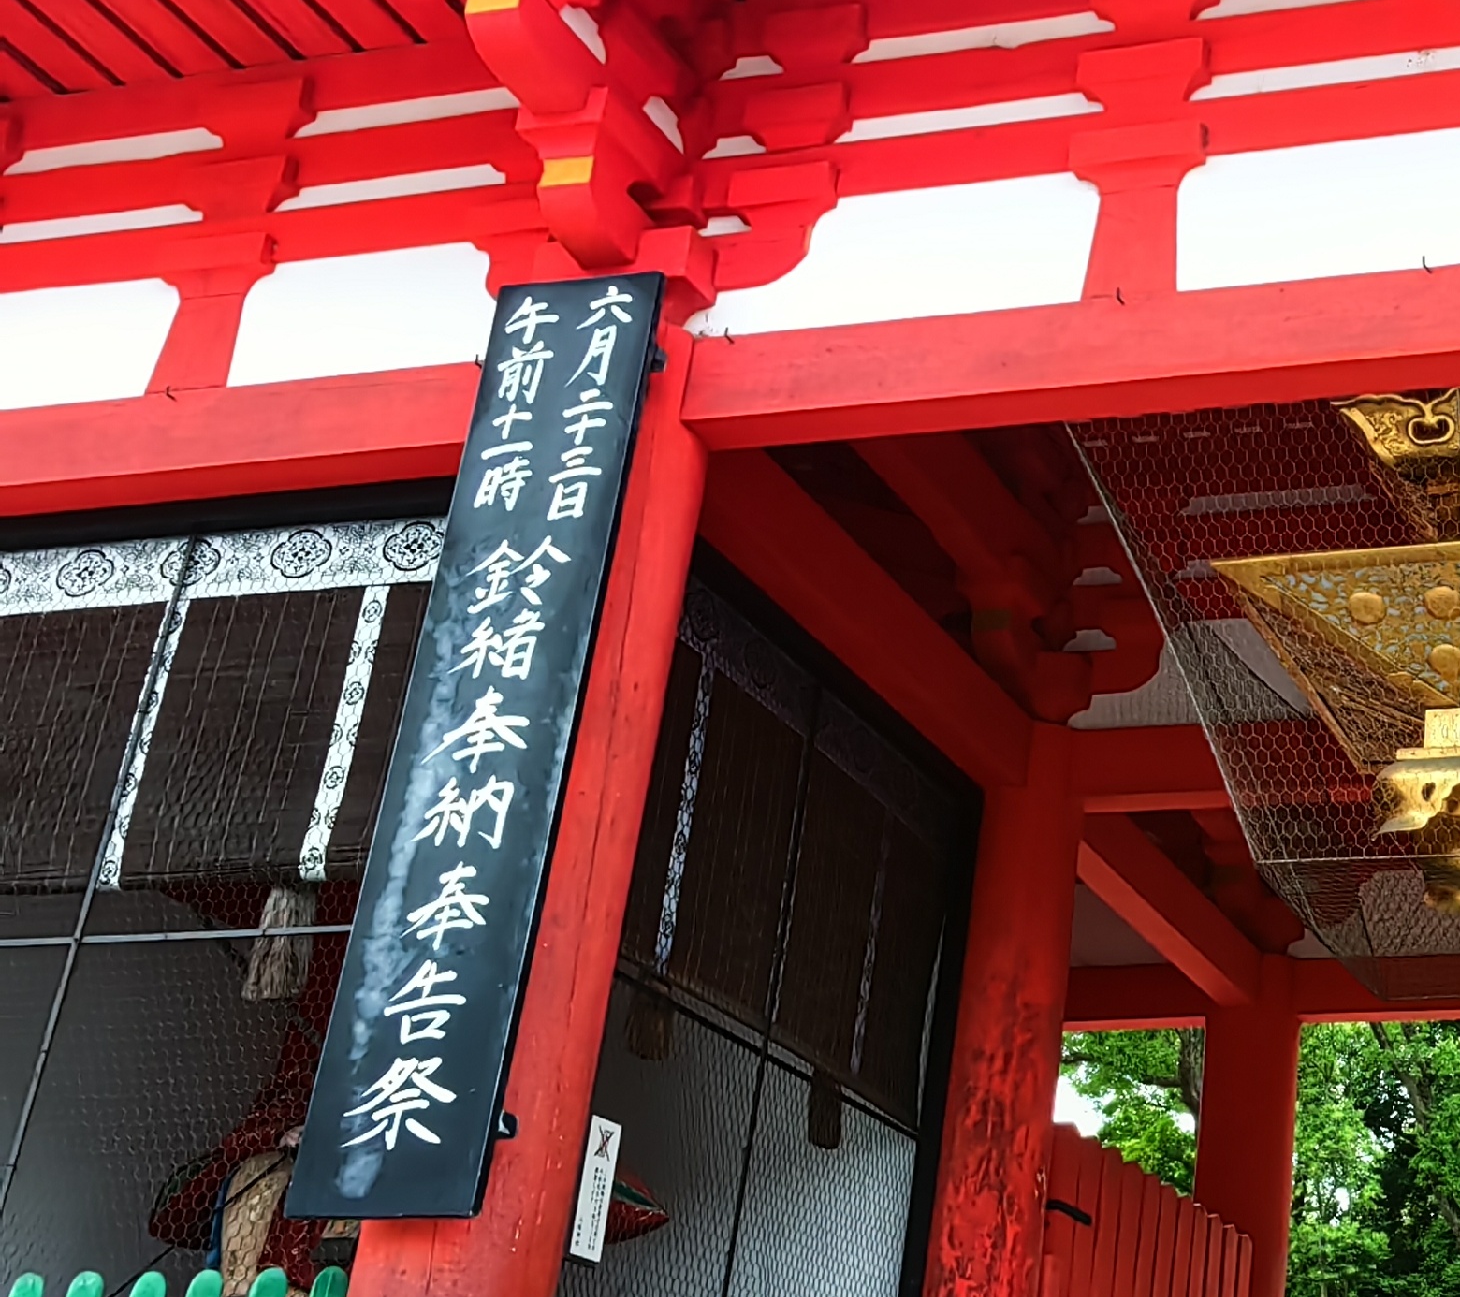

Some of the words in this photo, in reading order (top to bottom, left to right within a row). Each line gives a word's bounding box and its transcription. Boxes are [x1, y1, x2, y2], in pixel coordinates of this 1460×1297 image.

[474, 296, 559, 511] 午前十一時
[549, 285, 633, 521] 六月二十三日
[340, 535, 572, 1151] 鈴緒奉納奉告祭
